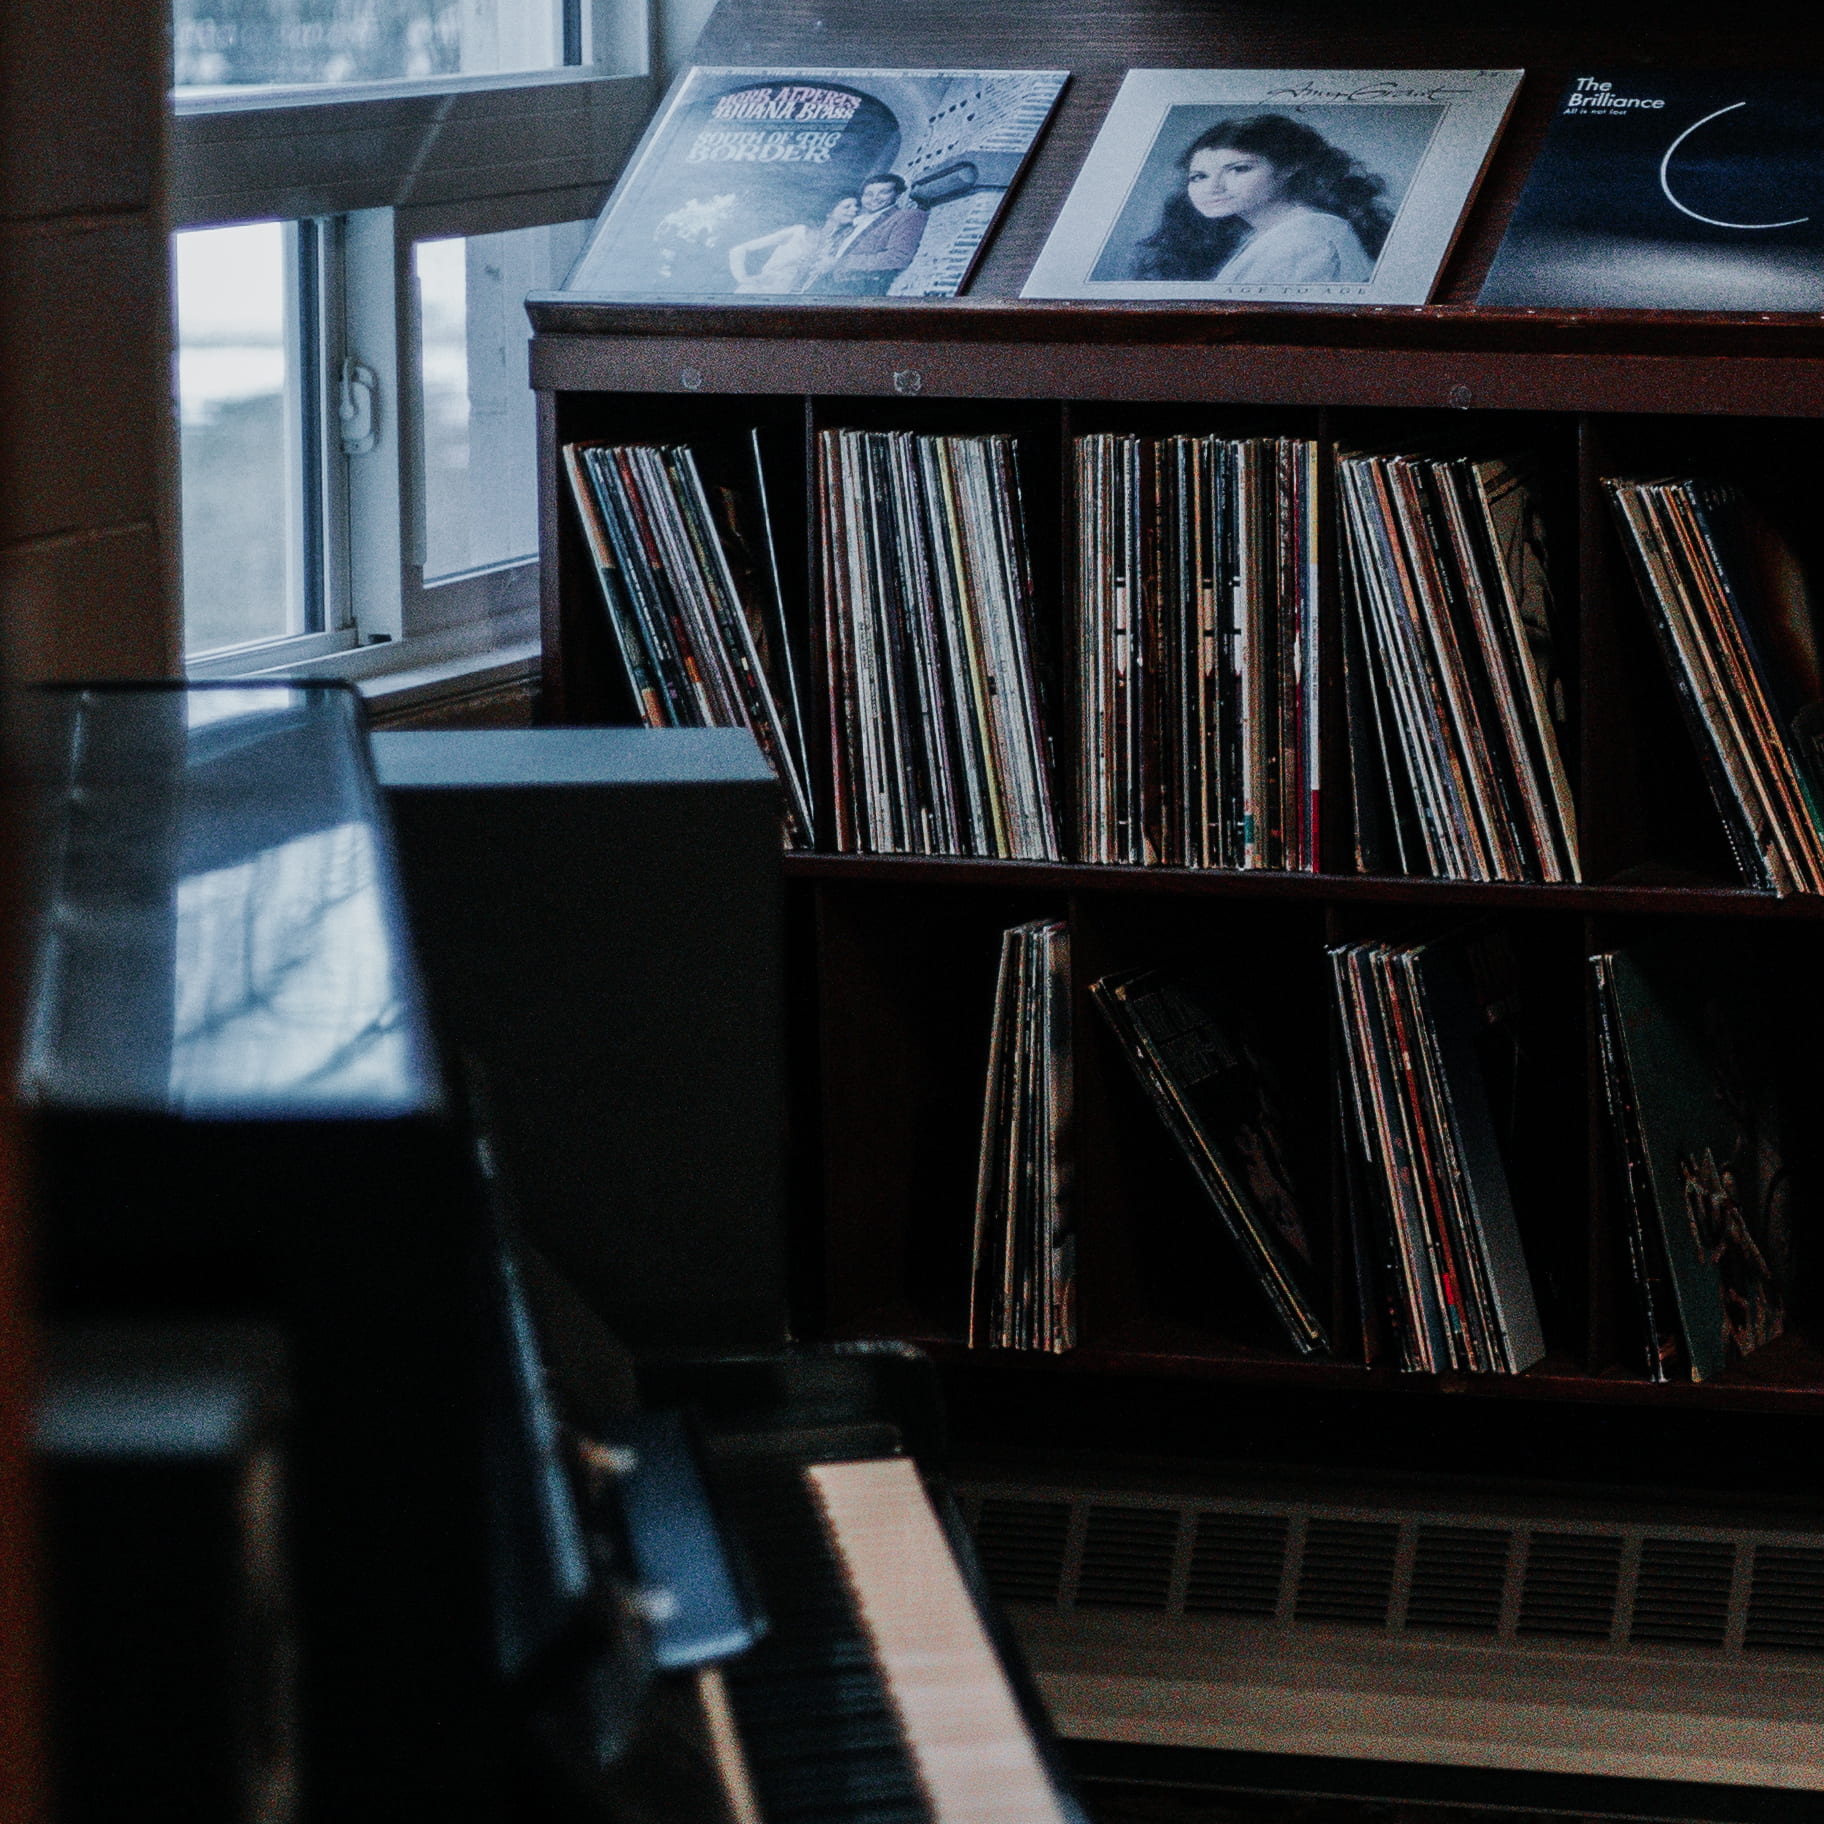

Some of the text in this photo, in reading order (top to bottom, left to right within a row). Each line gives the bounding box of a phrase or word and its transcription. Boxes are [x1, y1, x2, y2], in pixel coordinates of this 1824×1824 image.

[1577, 76, 1613, 91] The
[1567, 92, 1666, 109] Brilliance
[1563, 108, 1579, 116] All
[696, 131, 766, 145] SOUTH
[768, 131, 793, 145] OF
[686, 144, 831, 164] BORDER
